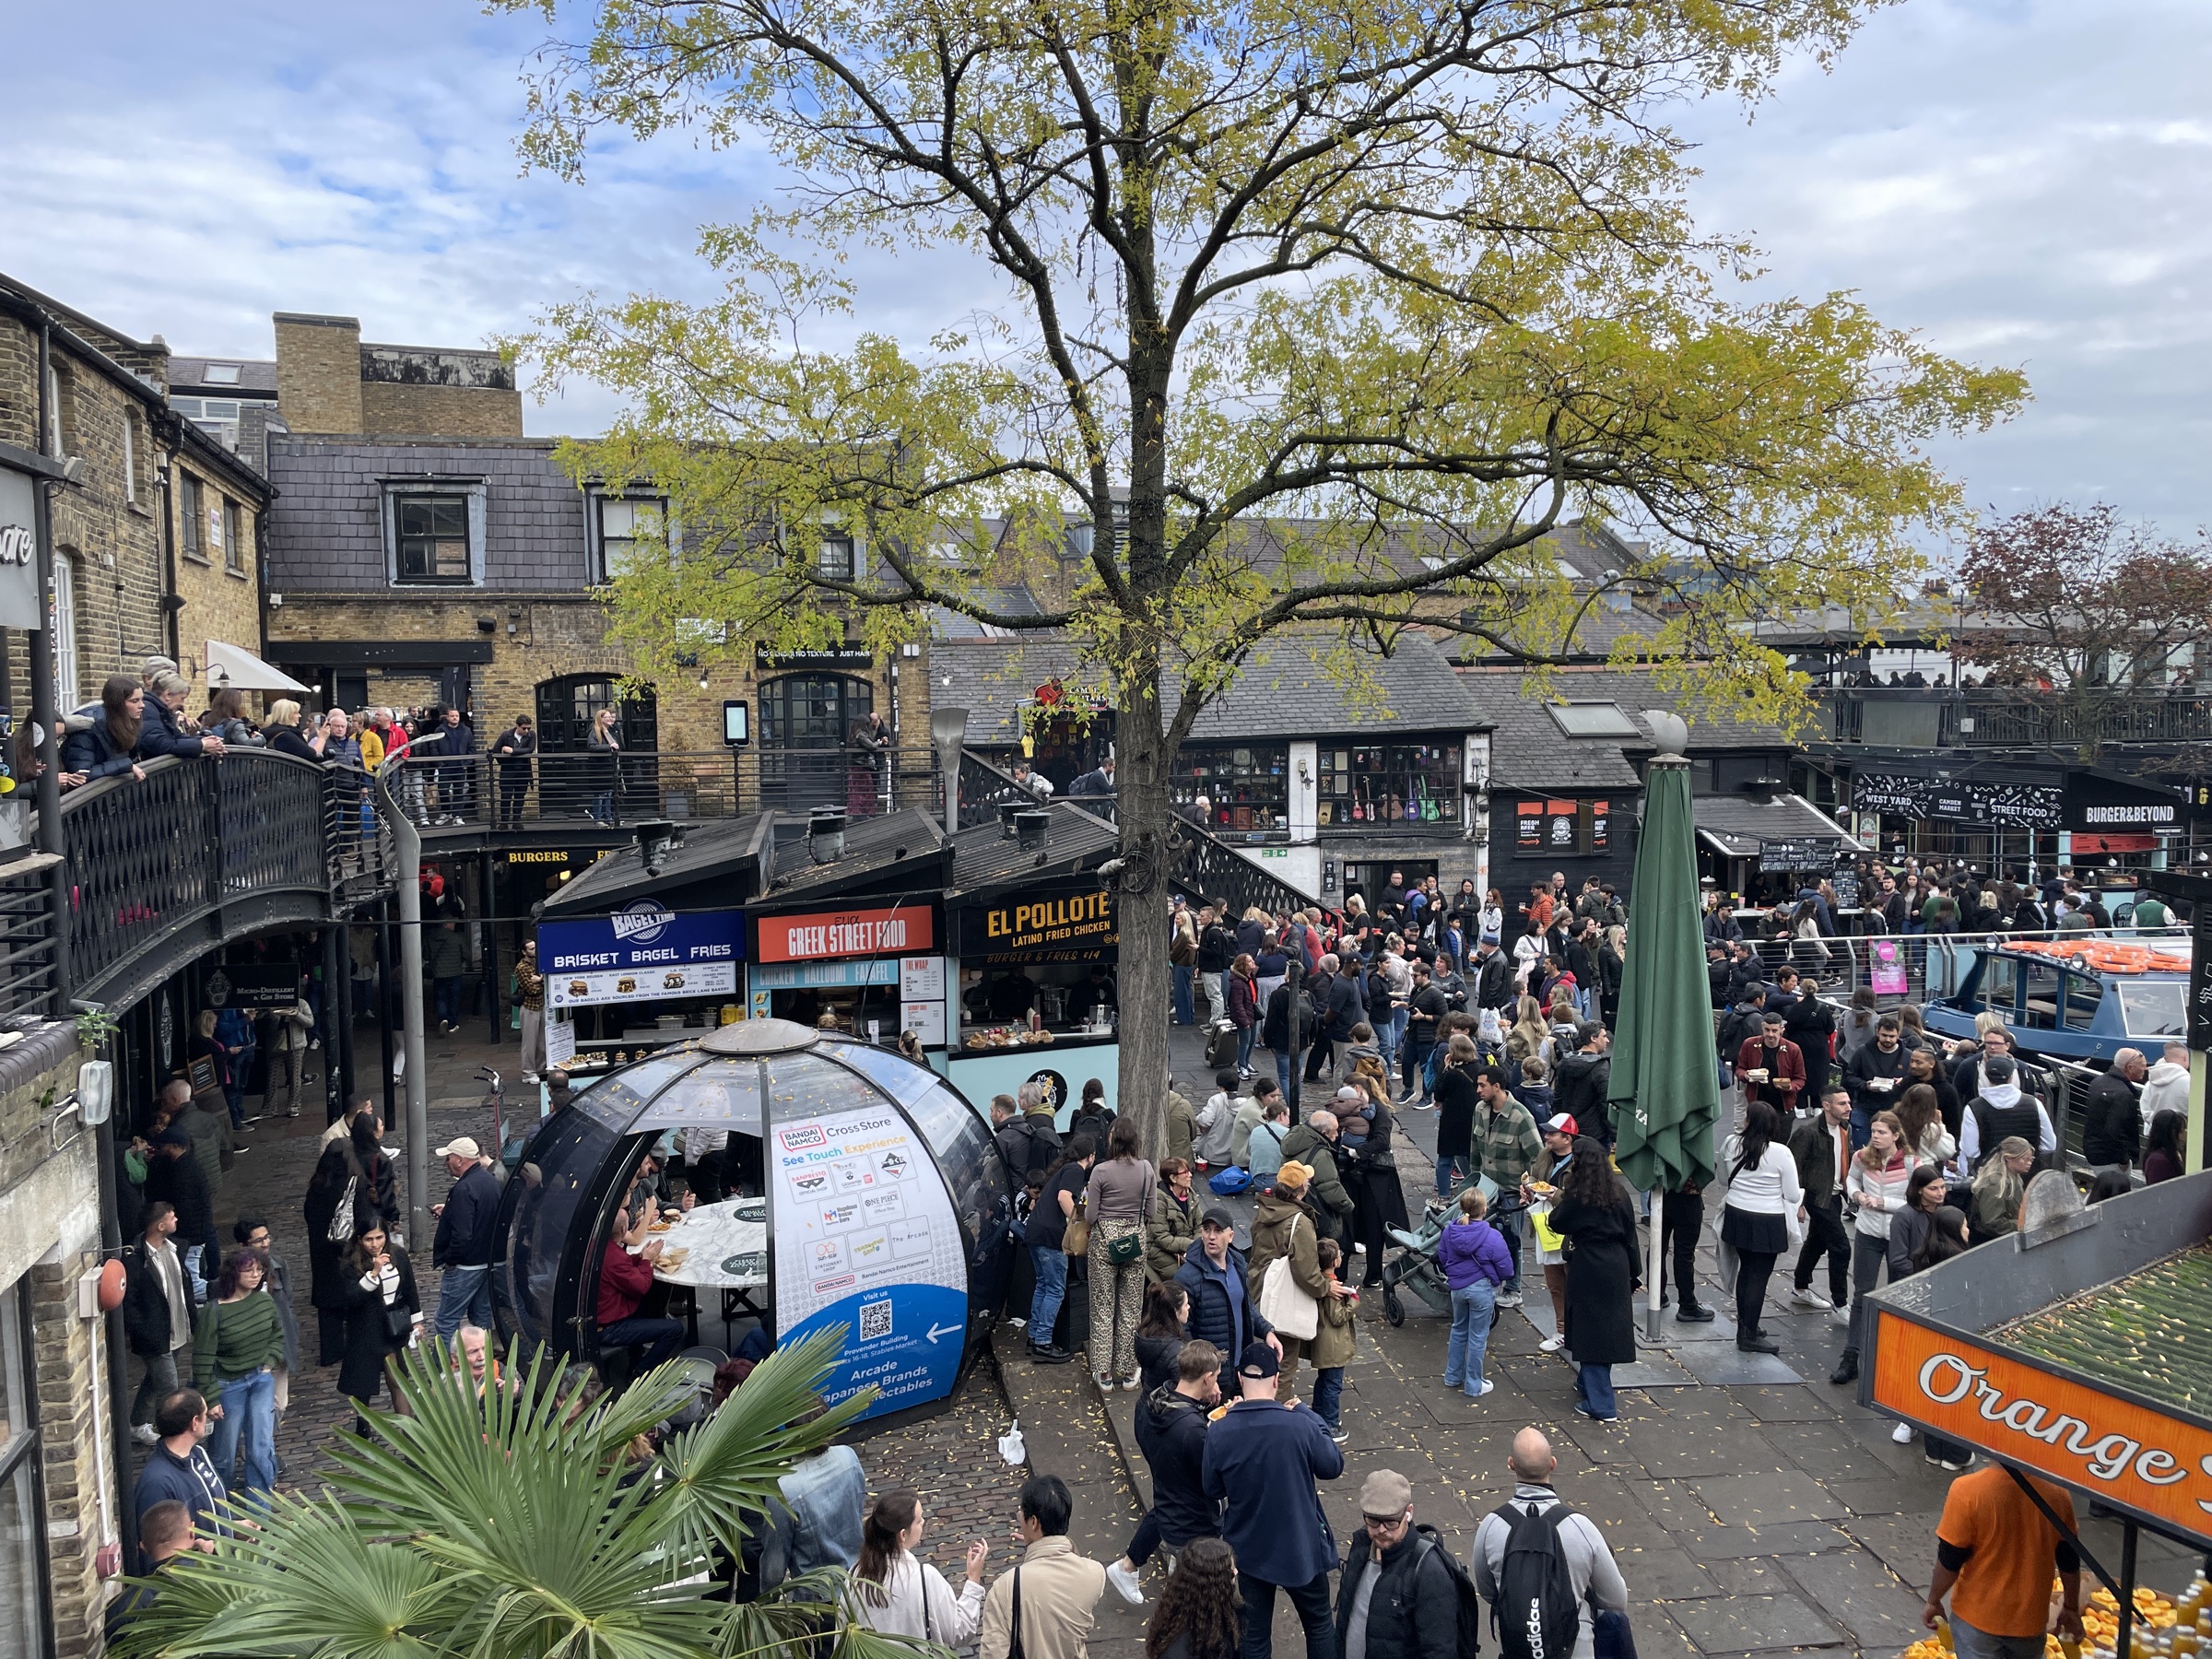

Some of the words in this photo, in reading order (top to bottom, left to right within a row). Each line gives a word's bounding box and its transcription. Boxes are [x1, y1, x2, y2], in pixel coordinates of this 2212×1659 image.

[1865, 794, 1888, 803] WEST
[1889, 796, 1912, 806] YARD
[1991, 805, 2020, 815] STREET
[2022, 807, 2047, 818] FOOD
[2087, 806, 2174, 823] BURGER&BEYOND
[509, 851, 569, 863] BURGERS
[611, 913, 653, 935] BAGEL
[653, 912, 676, 924] TIME
[988, 909, 1012, 937] EL
[1012, 932, 1042, 947] LATINO
[1046, 927, 1071, 941] FRIED
[1074, 920, 1111, 936] CHICKEN
[788, 925, 827, 957] GREEK
[829, 922, 873, 953] STREET
[877, 919, 906, 949] FOOD
[554, 952, 619, 968] BRISKET
[631, 947, 679, 961] BAGEL
[690, 944, 731, 959] FRIES
[987, 951, 1031, 963] BURGER
[1035, 952, 1042, 961] &
[1046, 951, 1078, 961] FRIES
[759, 967, 795, 986] CHICKEN
[805, 964, 846, 984] HALLOUMI
[854, 962, 889, 982] FALAFEL
[784, 1128, 818, 1141] BANDAI
[787, 1135, 821, 1147] NAMCO
[782, 1156, 804, 1167] See
[806, 1147, 842, 1161] Touch
[843, 1135, 906, 1155] Experience
[791, 1171, 827, 1182] BANPRESTO
[881, 1193, 899, 1204] PIECE
[862, 1271, 878, 1279] Bandai
[896, 1258, 930, 1271] Entertainment
[863, 1291, 878, 1301] Visit
[844, 1342, 879, 1357] Provender
[879, 1335, 909, 1349] Building
[871, 1347, 894, 1357] Stables
[895, 1339, 918, 1350] Market
[851, 1360, 898, 1382] Arcade
[819, 1381, 880, 1403] apanese
[882, 1366, 928, 1386] Brands
[1919, 1352, 2190, 1486] Orange
[1526, 1597, 1545, 1659] adidas
